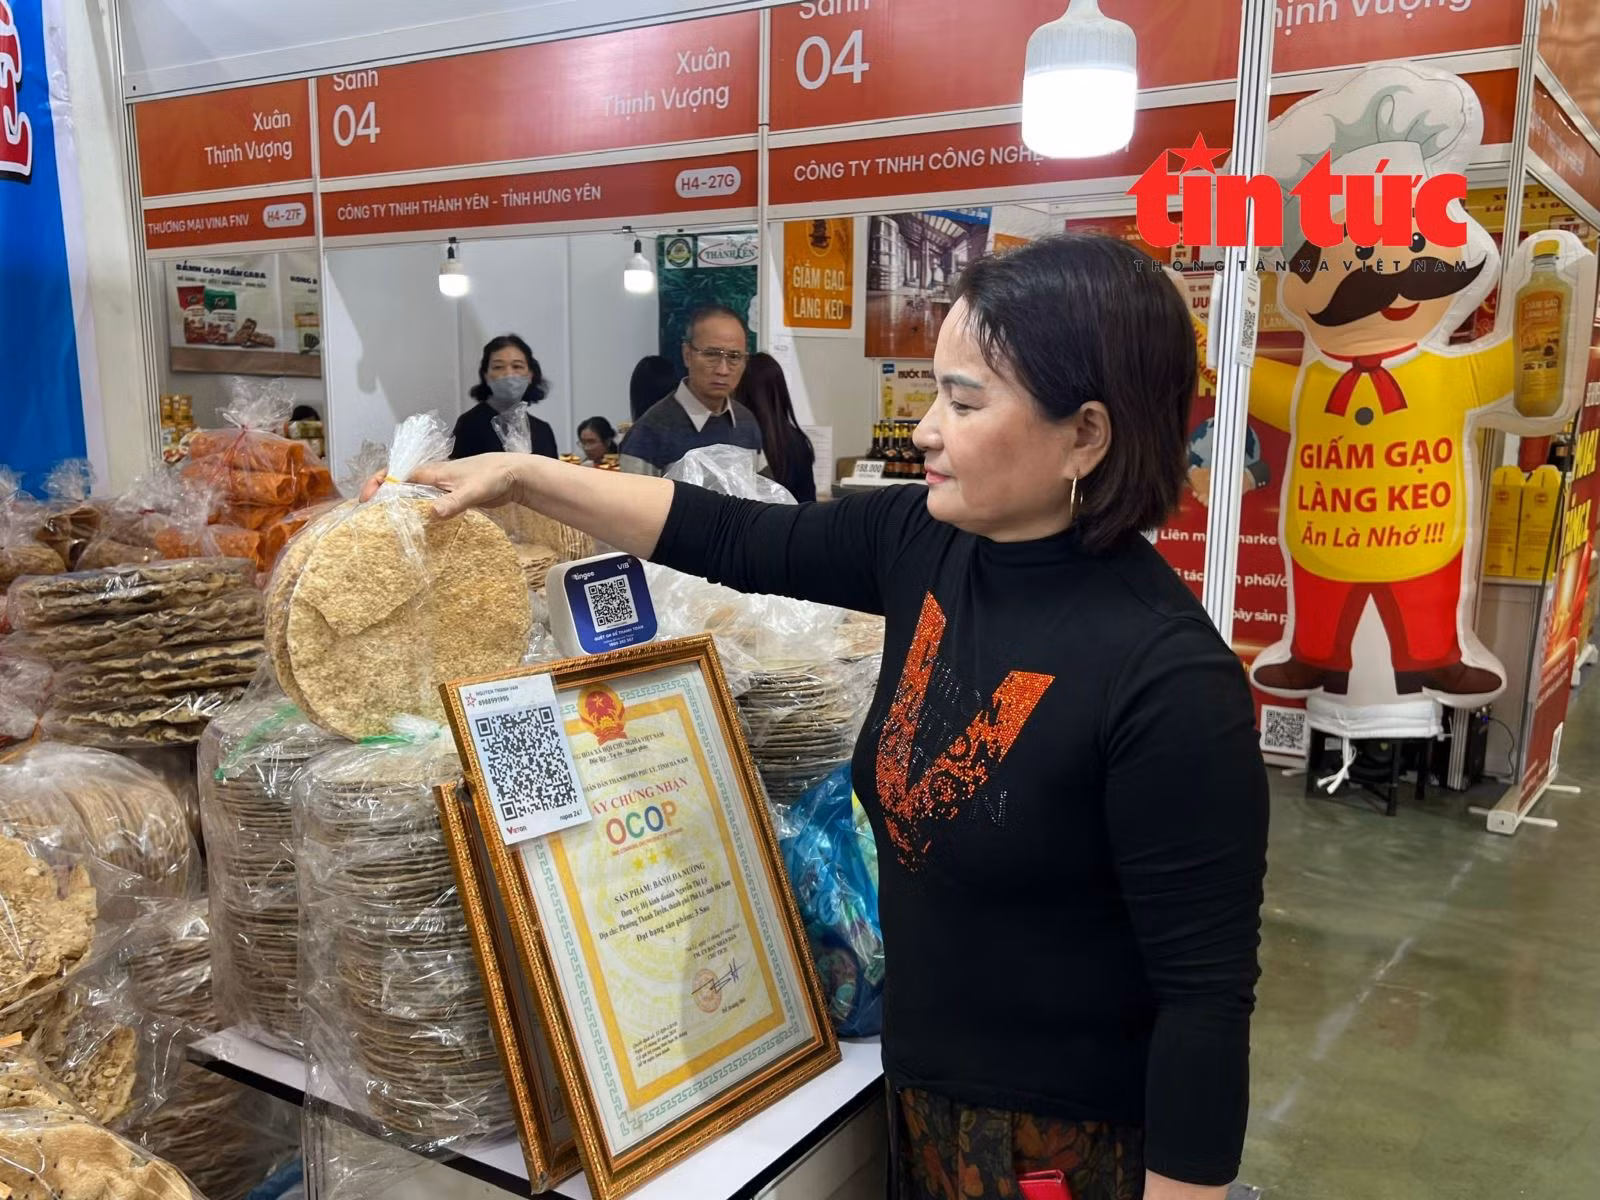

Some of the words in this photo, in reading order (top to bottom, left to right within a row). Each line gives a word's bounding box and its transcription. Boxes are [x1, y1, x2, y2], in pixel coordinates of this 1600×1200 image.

[677, 46, 730, 75] Xuân
[796, 29, 870, 90] 04
[604, 90, 655, 120] Thịnh
[661, 86, 730, 112] Vượng
[253, 109, 291, 131] Xuân
[333, 101, 380, 146] 04
[204, 145, 243, 168] Thịnh
[245, 141, 292, 162] Vượng
[794, 160, 844, 181] CÔNG
[848, 159, 871, 177] TY
[875, 155, 924, 174] TNHH
[928, 147, 984, 170] CÔNG
[681, 172, 735, 191] H4-27G
[267, 208, 302, 222] H4-27F
[337, 203, 370, 220] CÔNG
[372, 204, 386, 218] TY
[388, 201, 420, 217] TNHH
[422, 195, 462, 214] THÀNH
[464, 192, 489, 210] YÊN
[501, 187, 531, 207] TỈNH
[533, 187, 572, 205] HƯNG
[574, 183, 601, 200] YÊN
[147, 219, 186, 235] THƯƠNG
[187, 218, 204, 233] MẠI
[206, 215, 229, 230] VINA
[229, 214, 249, 227] FNV
[793, 260, 820, 290] GIẤM
[824, 269, 845, 296] GẠO
[793, 293, 821, 319] LÀNG
[824, 299, 844, 320] KEO
[1300, 434, 1374, 470] GIẤM
[1384, 437, 1454, 474] GẠO
[1298, 481, 1377, 513] LÀNG
[1387, 481, 1452, 512] KEO
[1301, 521, 1327, 546] Ăn
[1332, 527, 1361, 548] Là
[1366, 523, 1421, 548] Nhớ
[606, 800, 678, 846] OCOP
